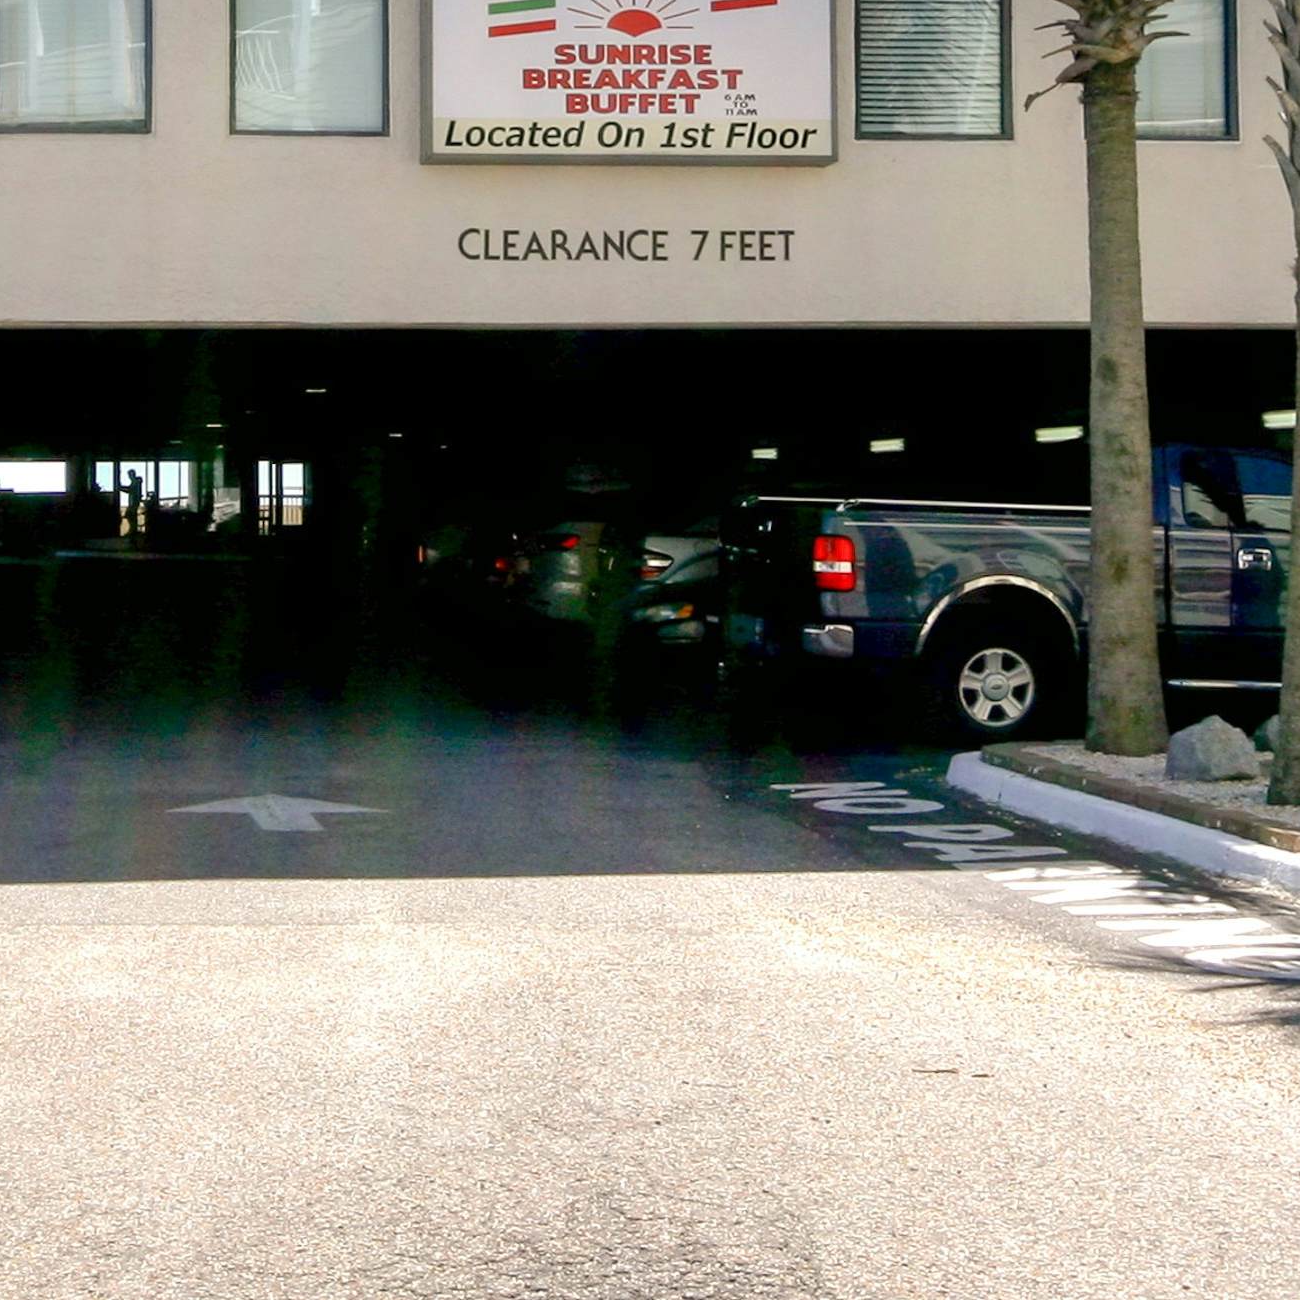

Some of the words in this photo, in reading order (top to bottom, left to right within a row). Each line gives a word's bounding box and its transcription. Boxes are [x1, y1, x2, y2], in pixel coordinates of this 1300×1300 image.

[554, 44, 712, 65] SUNRISE
[522, 69, 743, 90] BREAKFAST
[565, 93, 701, 114] BUFFET
[445, 120, 587, 147] Located
[598, 122, 645, 148] On
[660, 123, 714, 148] 1st
[726, 122, 818, 149] Floor
[457, 228, 669, 261] CLEARANCE
[690, 230, 709, 261] 7
[719, 230, 795, 261] FEET
[770, 781, 945, 814] NO
